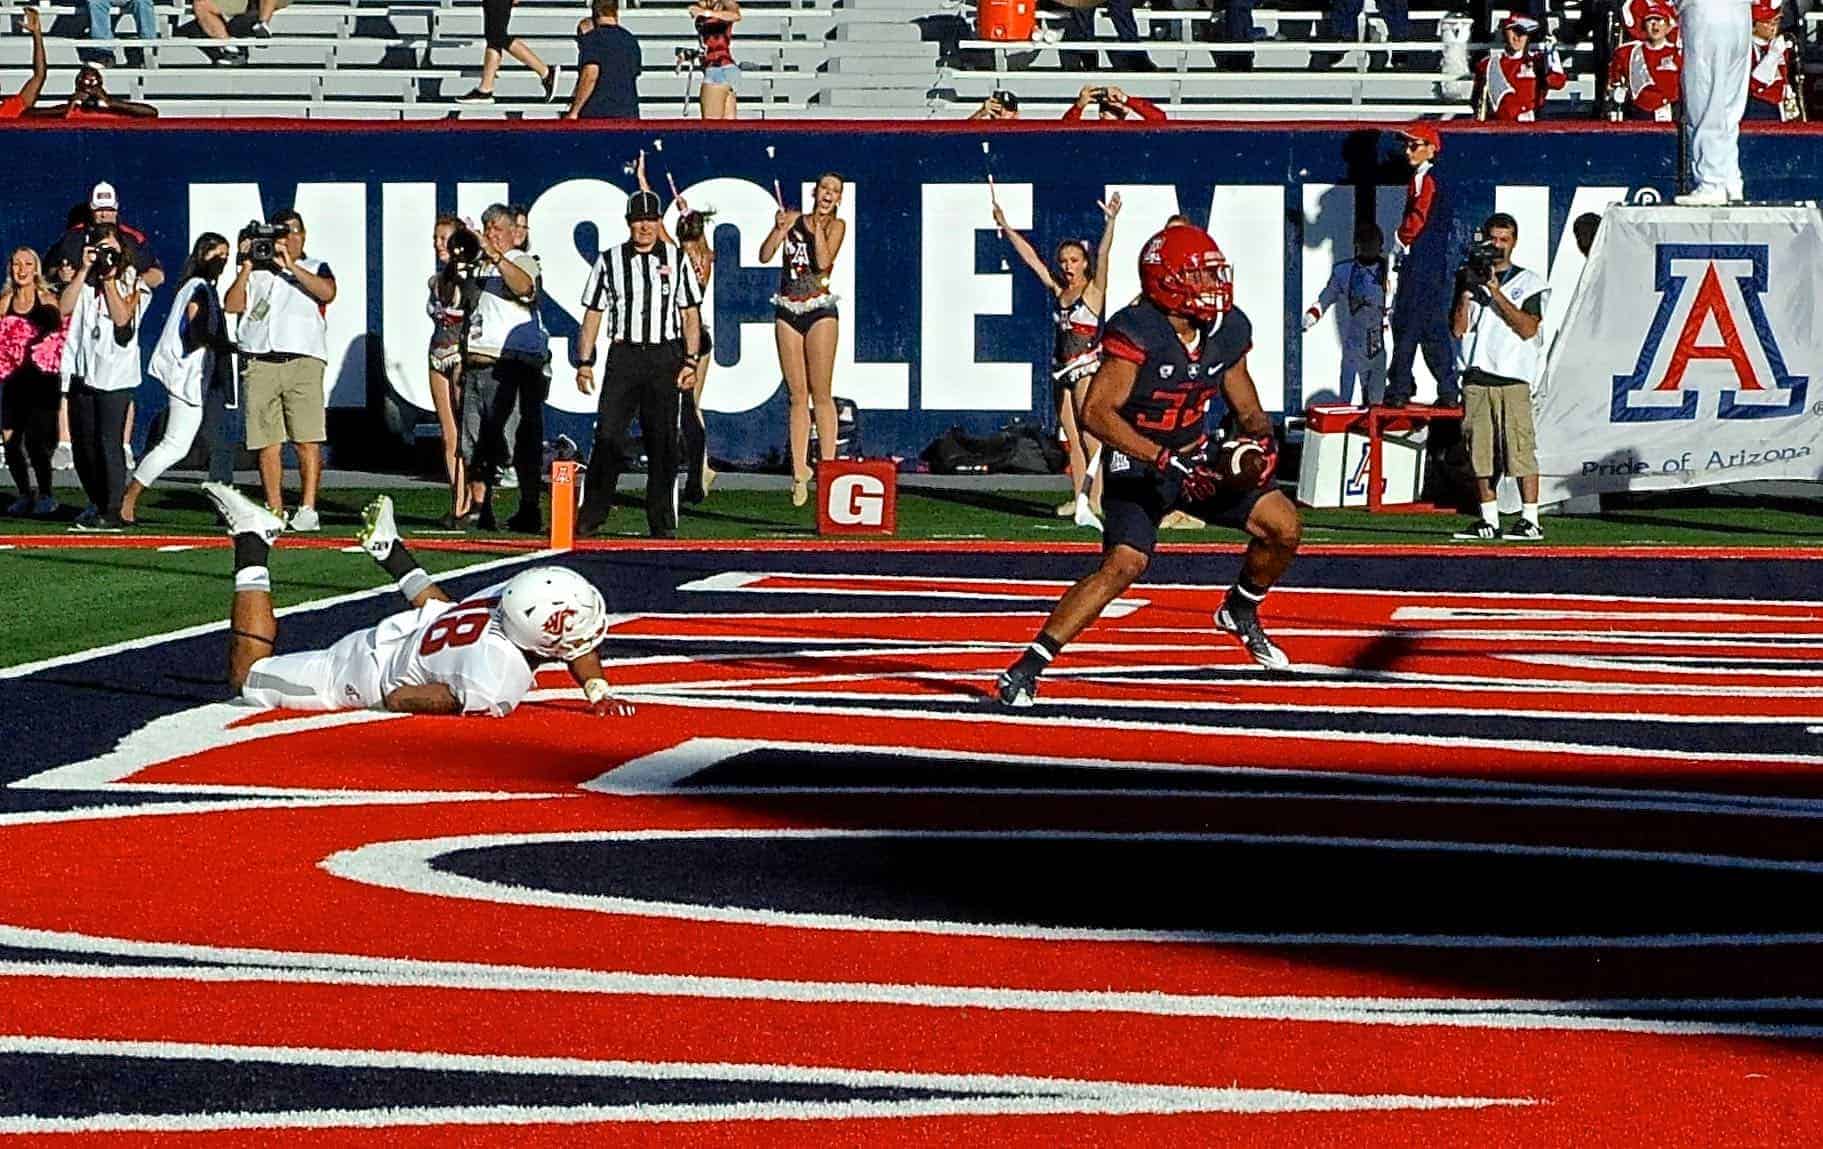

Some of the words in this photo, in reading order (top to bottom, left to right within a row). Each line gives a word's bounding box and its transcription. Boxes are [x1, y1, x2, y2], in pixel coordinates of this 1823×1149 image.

[188, 178, 1033, 414] MUSCLE
[1609, 243, 1809, 423] A
[828, 474, 885, 526] G
[1582, 459, 1649, 476] Pride
[1662, 452, 1692, 473] of
[1705, 446, 1811, 470] Arizona
